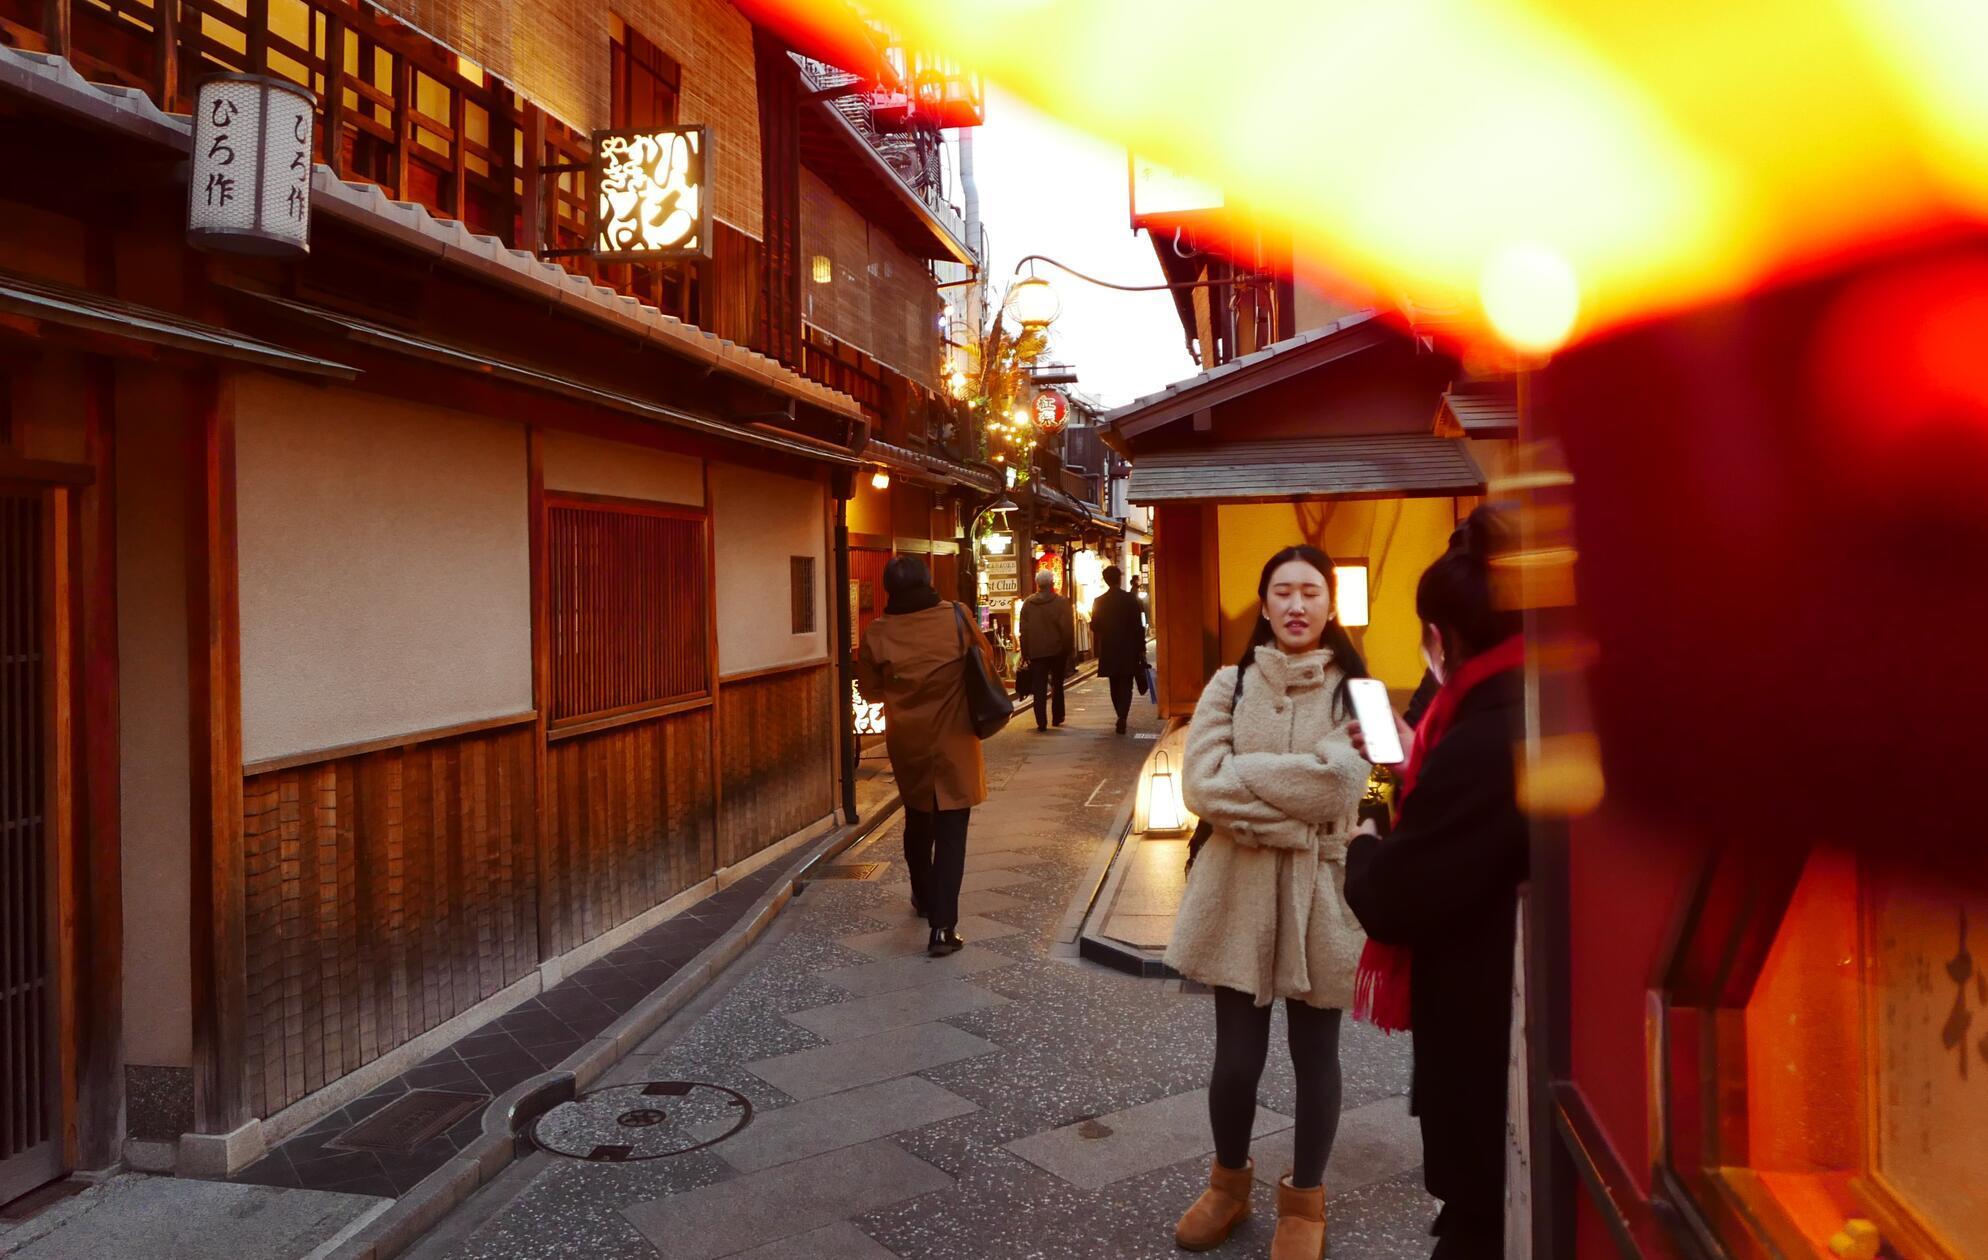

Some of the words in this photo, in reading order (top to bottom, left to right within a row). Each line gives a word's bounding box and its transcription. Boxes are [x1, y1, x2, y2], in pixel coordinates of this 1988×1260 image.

[205, 98, 238, 207] ひろ作
[996, 579, 1017, 591] Club
